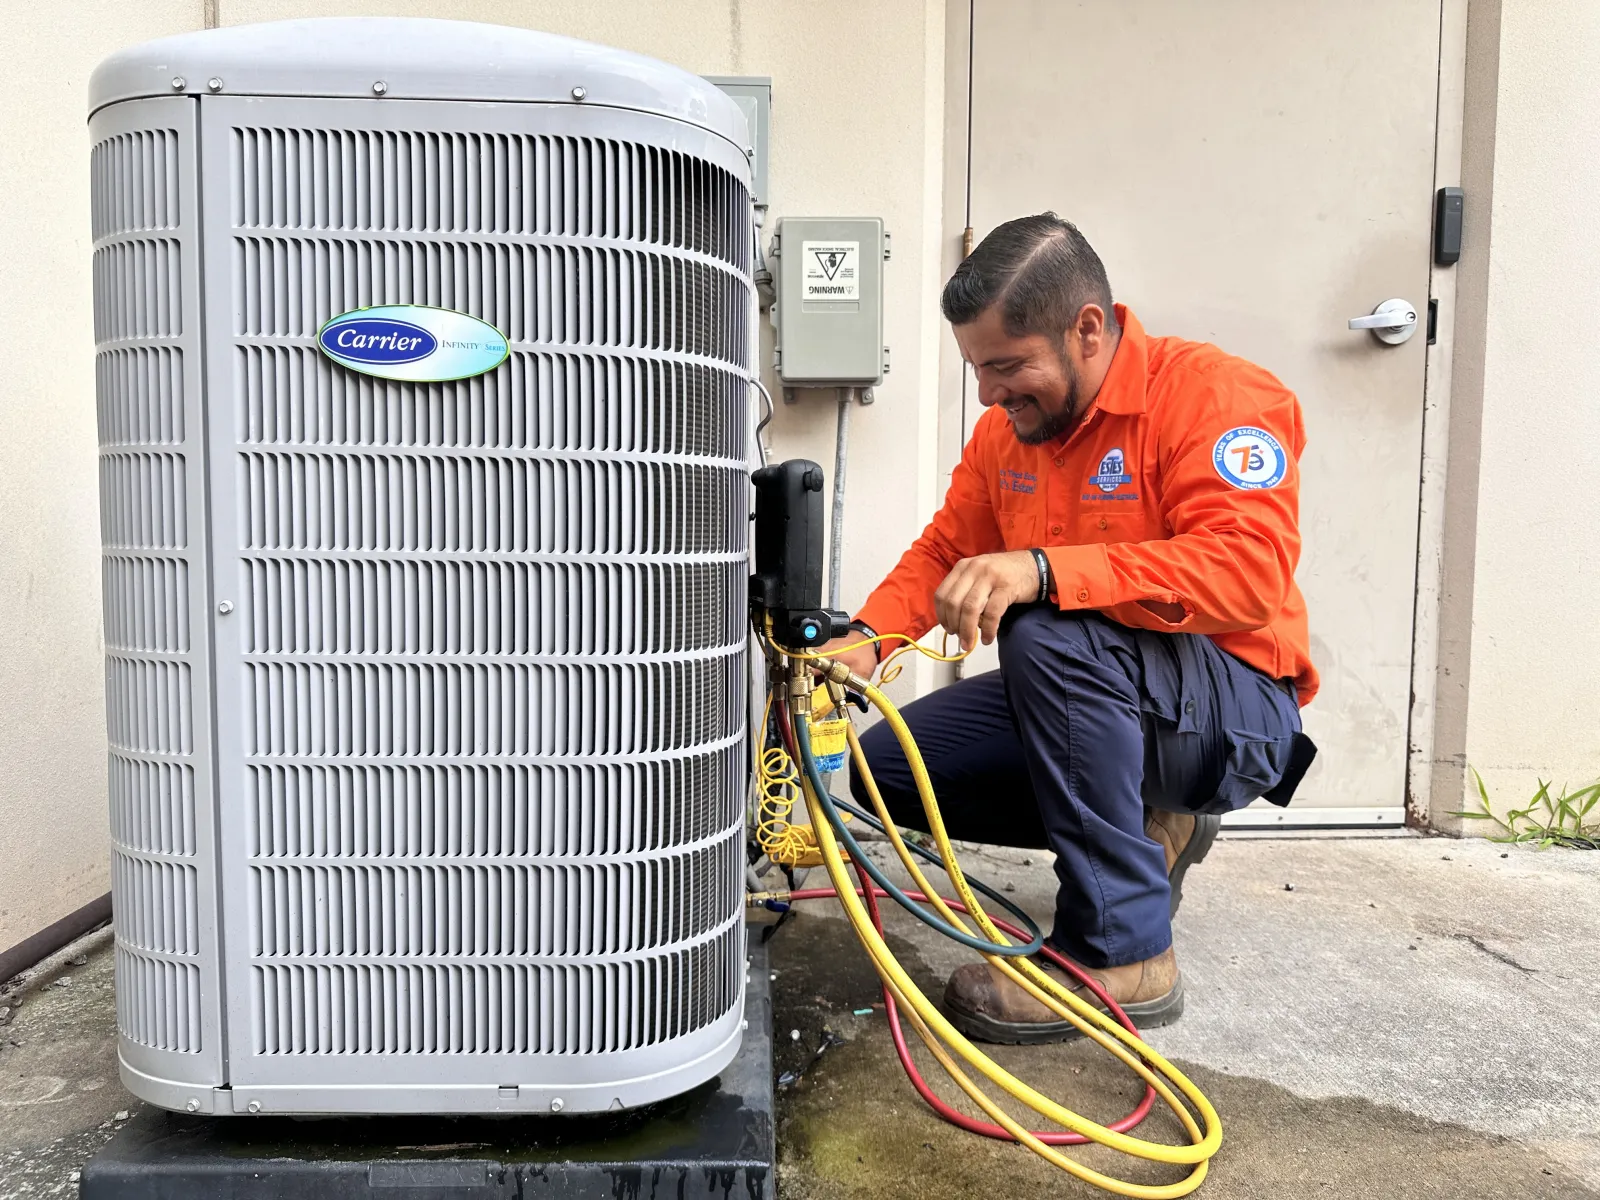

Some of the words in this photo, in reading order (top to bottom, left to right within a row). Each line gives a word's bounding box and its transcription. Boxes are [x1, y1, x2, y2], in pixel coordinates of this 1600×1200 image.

[808, 286, 845, 294] WARNING
[337, 329, 422, 351] Carrier
[441, 339, 480, 350] INFINITY
[484, 343, 506, 351] SERIES
[1215, 441, 1227, 462] YEARS
[1225, 432, 1235, 441] OF
[1237, 429, 1280, 451] EXCELLENCE
[1100, 456, 1123, 476] ESTES
[1096, 476, 1122, 484] SERVICES
[1240, 481, 1263, 489] SINCE
